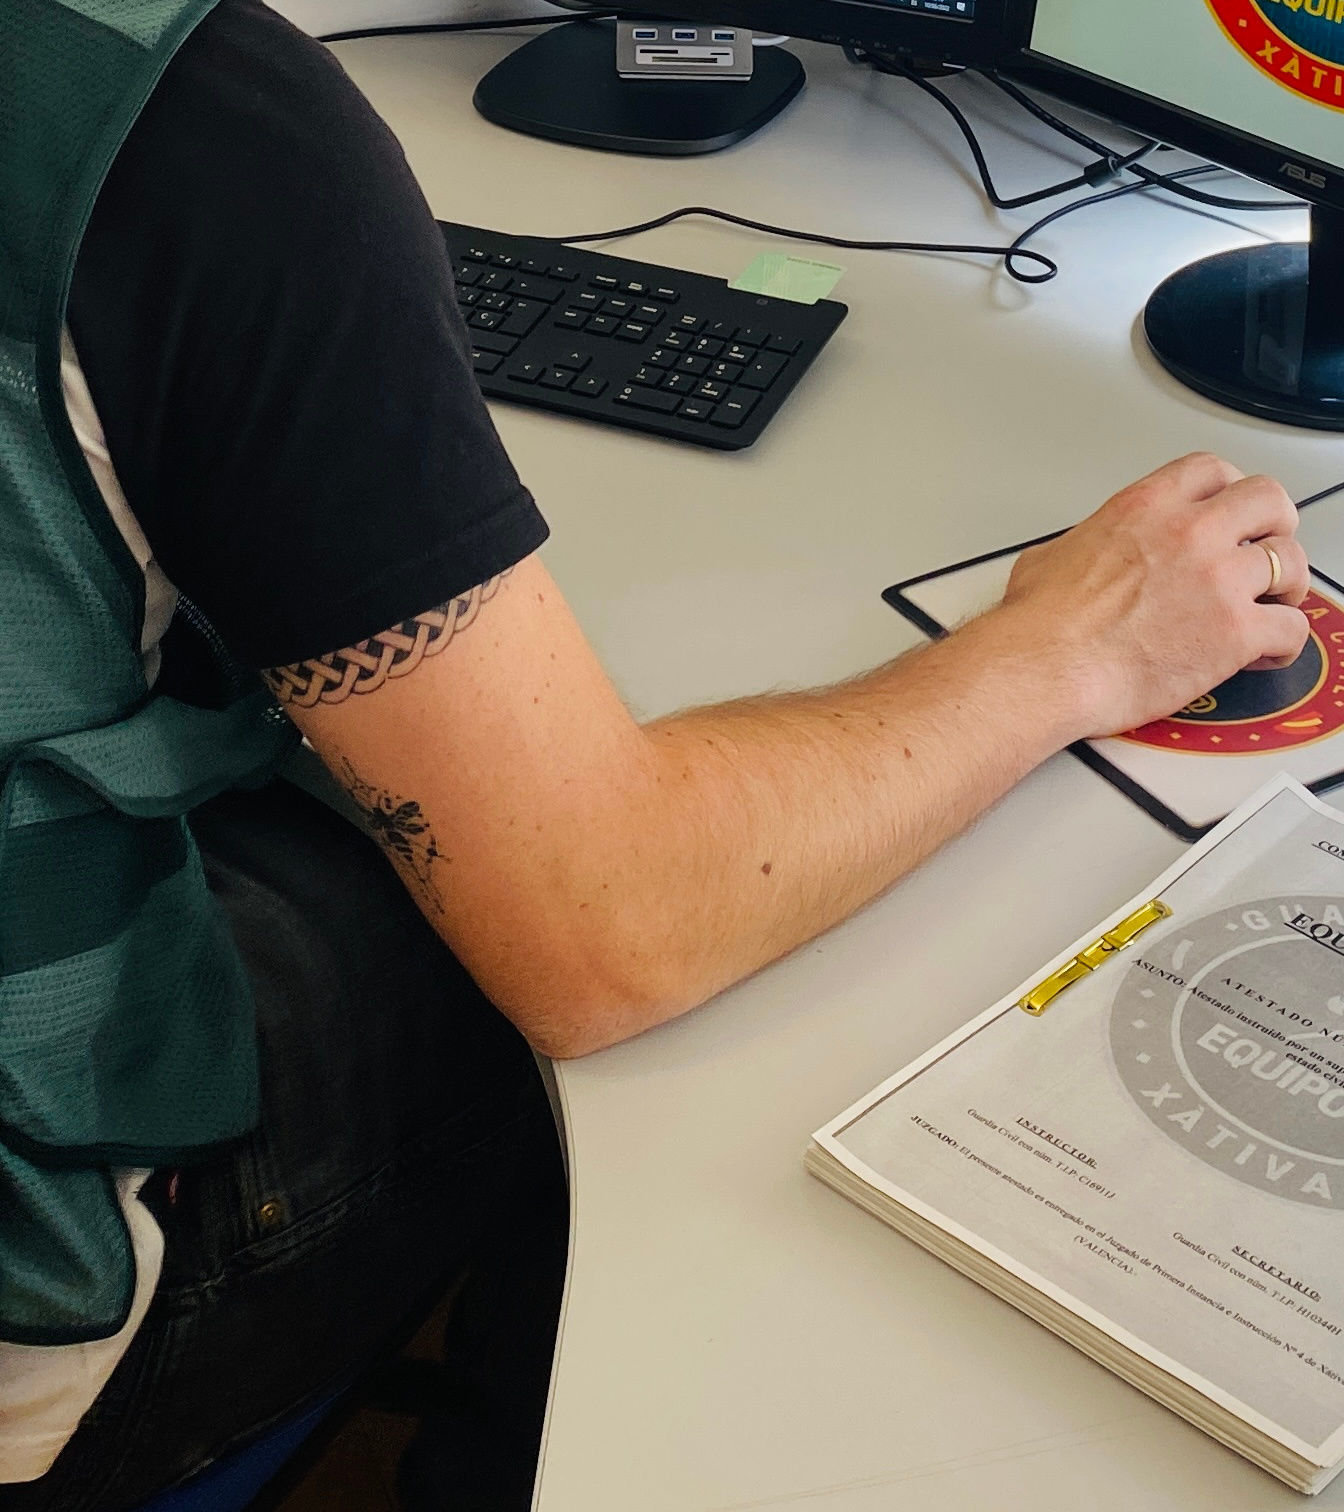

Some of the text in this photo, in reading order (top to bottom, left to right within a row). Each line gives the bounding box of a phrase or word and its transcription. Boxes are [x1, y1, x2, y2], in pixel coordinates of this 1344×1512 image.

[1278, 162, 1326, 189] ASUS
[1135, 958, 1186, 987] ASUNTO:
[1190, 986, 1235, 1014] Atestado
[1235, 1011, 1285, 1041] instruido
[1284, 1040, 1308, 1051] por
[1309, 1051, 1324, 1061] un
[1221, 978, 1312, 1026] ATESTADO
[1285, 1052, 1321, 1073] estado
[967, 1108, 997, 1129] Guardia
[997, 1127, 1020, 1142] Civil
[1017, 1140, 1033, 1151] con
[1032, 1149, 1052, 1163] núm.
[1016, 1117, 1097, 1168] INSTRUCTOR:
[910, 1115, 958, 1148] JUZGADO:
[958, 1146, 971, 1155] El
[966, 1153, 1001, 1175] presente
[1000, 1174, 1034, 1195] atestado
[1044, 1200, 1084, 1225] entregado
[1084, 1224, 1095, 1232] en
[1104, 1236, 1139, 1259] Juzgado
[1139, 1257, 1151, 1266] de
[1151, 1264, 1185, 1287] Primera
[1185, 1284, 1224, 1311] Instancia
[1232, 1312, 1281, 1345] Instrucción
[1304, 1357, 1316, 1366] de
[1172, 1232, 1206, 1255] Guardia
[1207, 1253, 1230, 1269] Civil
[1229, 1267, 1246, 1279] con
[1246, 1277, 1267, 1293] núm.
[1231, 1245, 1321, 1301] SECRETARIO:
